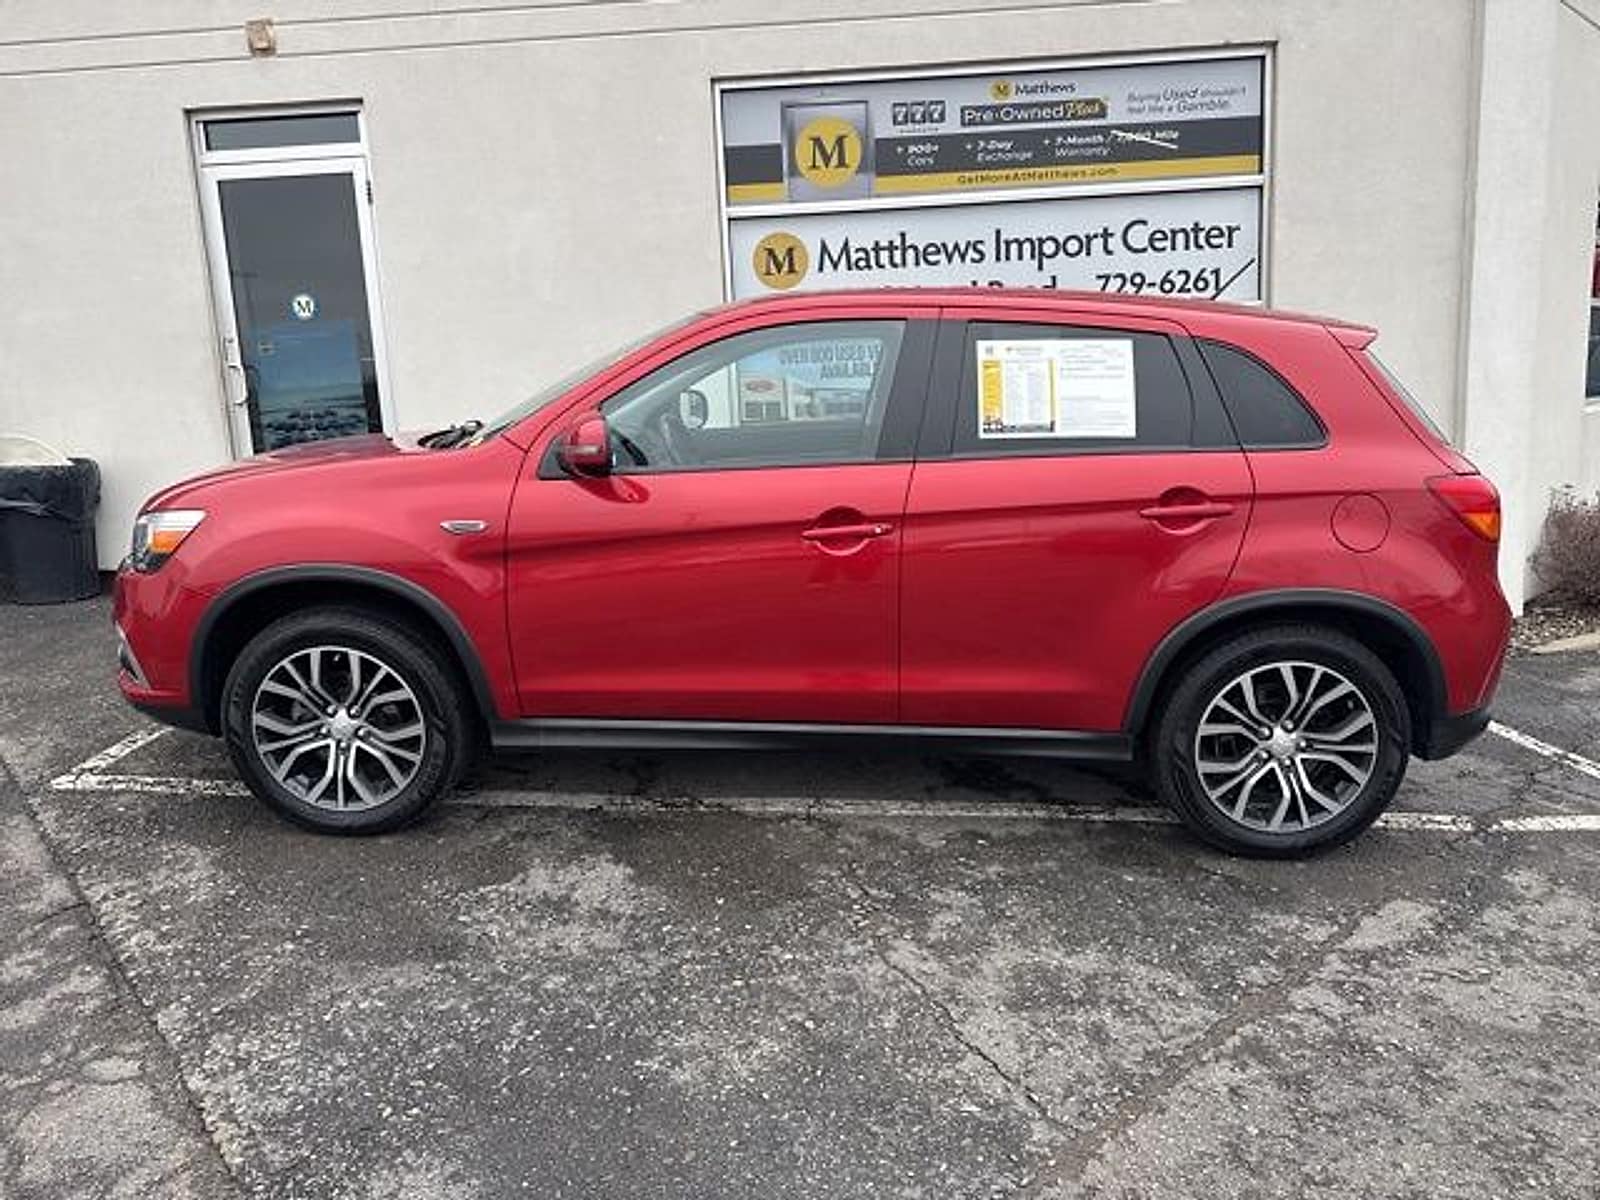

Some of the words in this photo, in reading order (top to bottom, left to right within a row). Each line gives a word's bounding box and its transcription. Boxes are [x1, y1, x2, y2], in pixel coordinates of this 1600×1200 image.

[1015, 80, 1076, 95] Matthews
[1163, 87, 1199, 101] Used
[808, 135, 849, 169] M
[977, 151, 1033, 163] Exchange
[907, 155, 934, 166] Cars
[957, 167, 1120, 184] GetMoreAtMatthews.com
[763, 247, 799, 276] M
[817, 231, 986, 273] Matthews
[994, 227, 1115, 272] Import
[1121, 219, 1241, 254] Center
[1095, 267, 1222, 294] 729-6261
